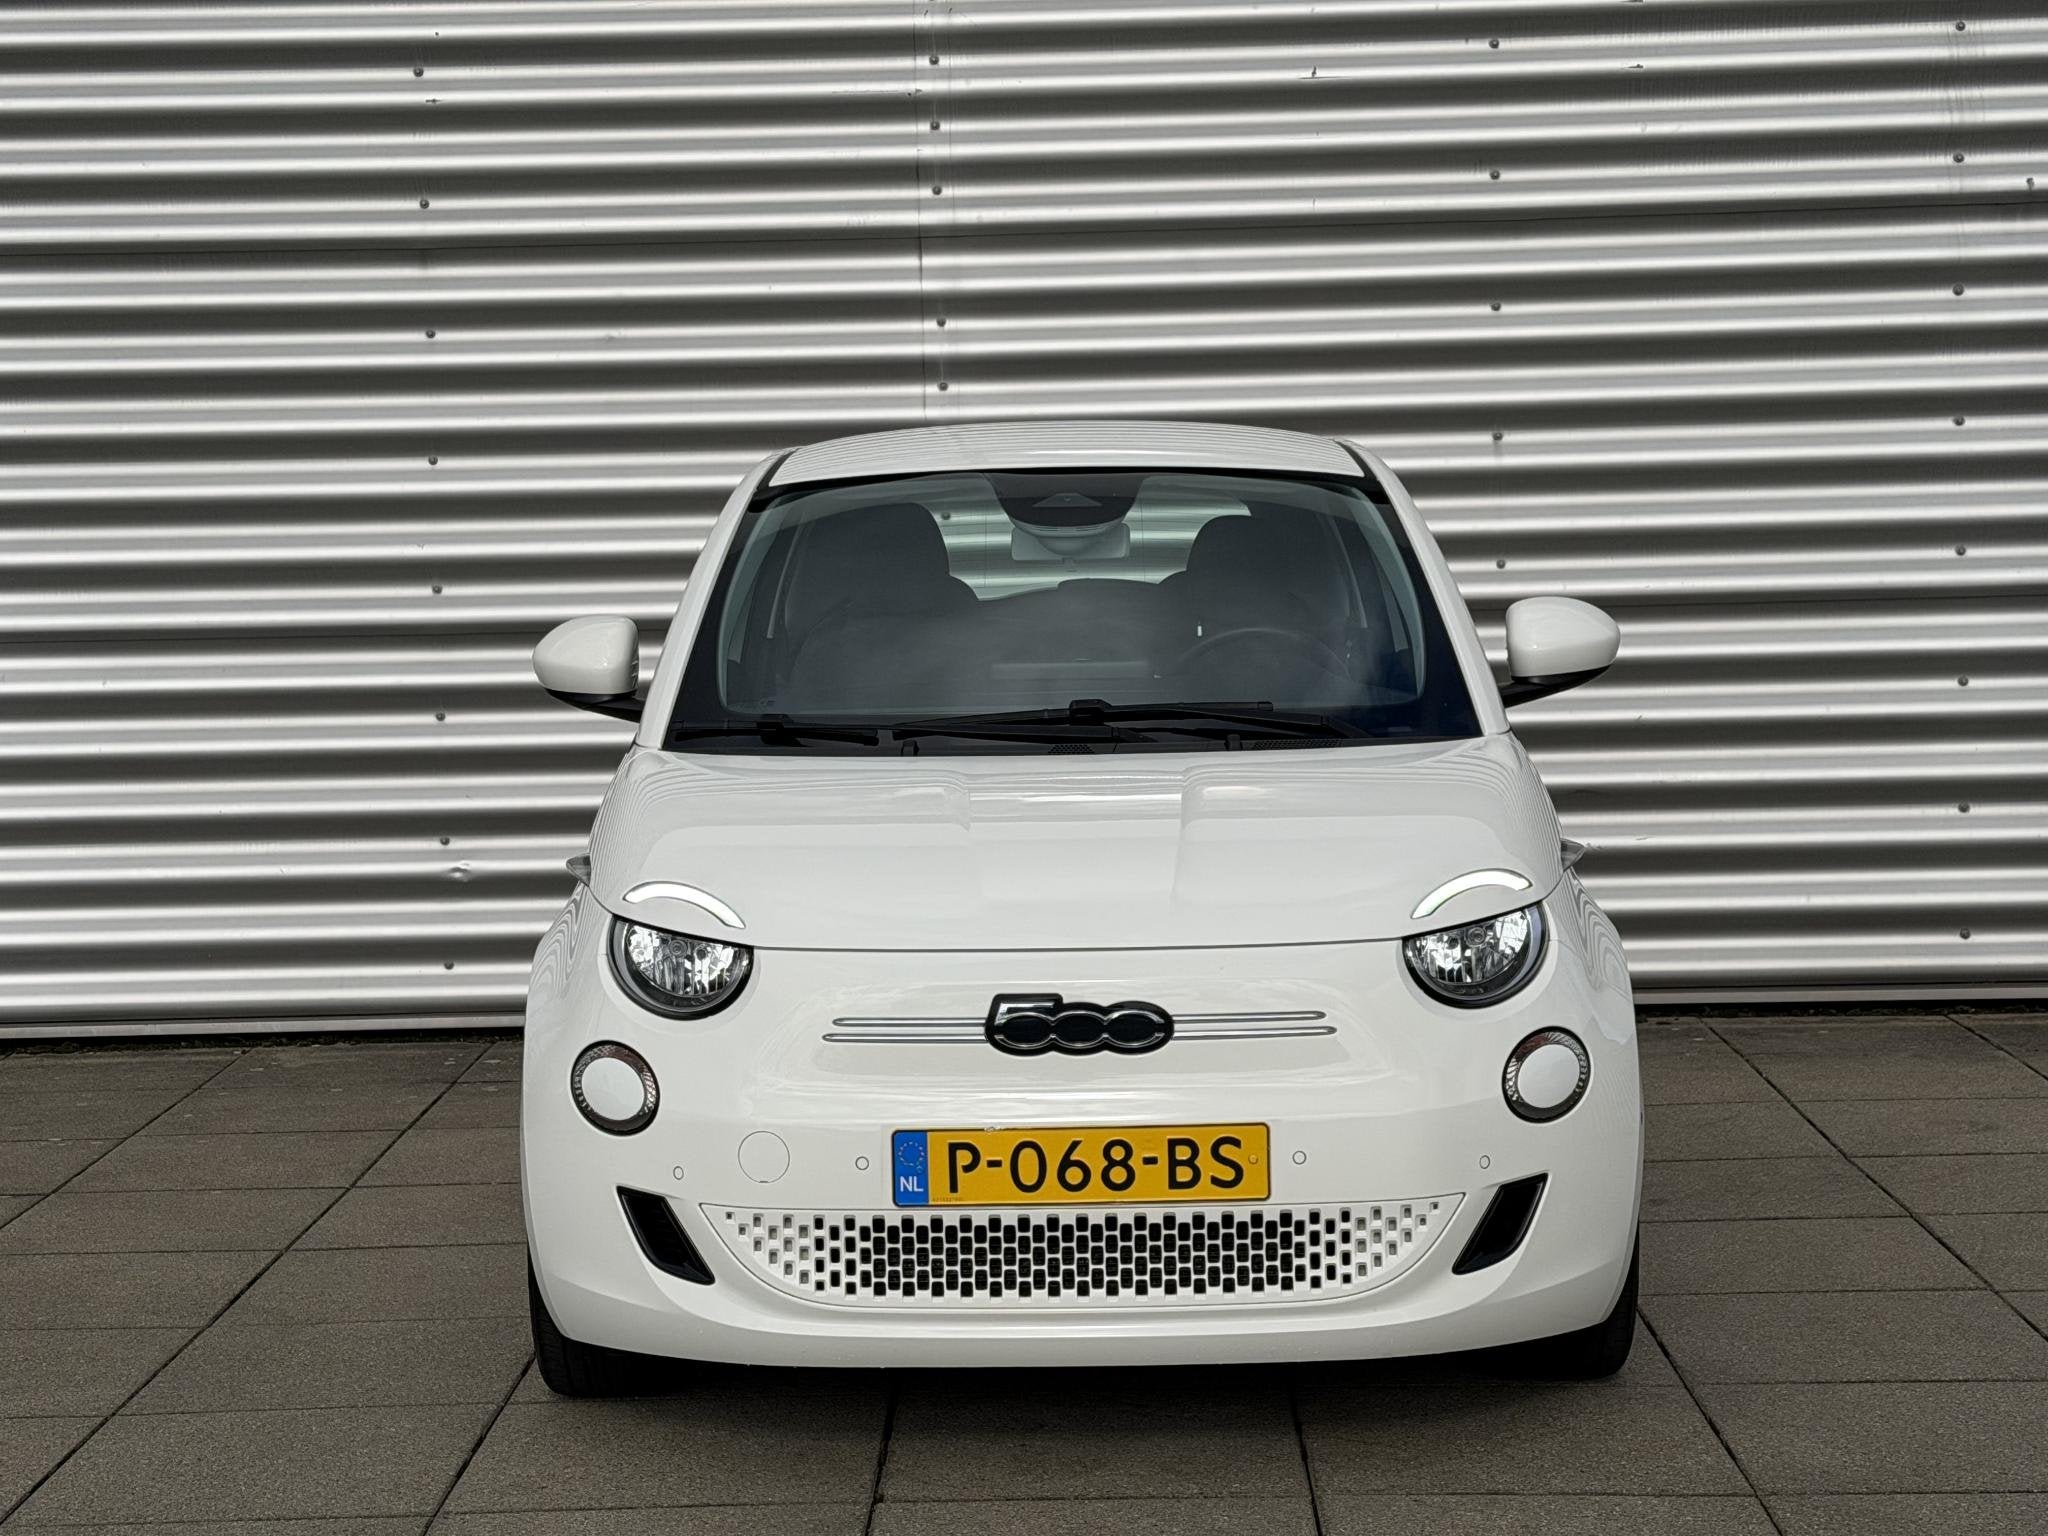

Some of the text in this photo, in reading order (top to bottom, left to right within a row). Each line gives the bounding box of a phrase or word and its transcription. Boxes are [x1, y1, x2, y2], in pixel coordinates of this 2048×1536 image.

[986, 993, 1173, 1055] 500
[900, 1176, 924, 1192] NL
[948, 1136, 1244, 1193] P-068-BS
